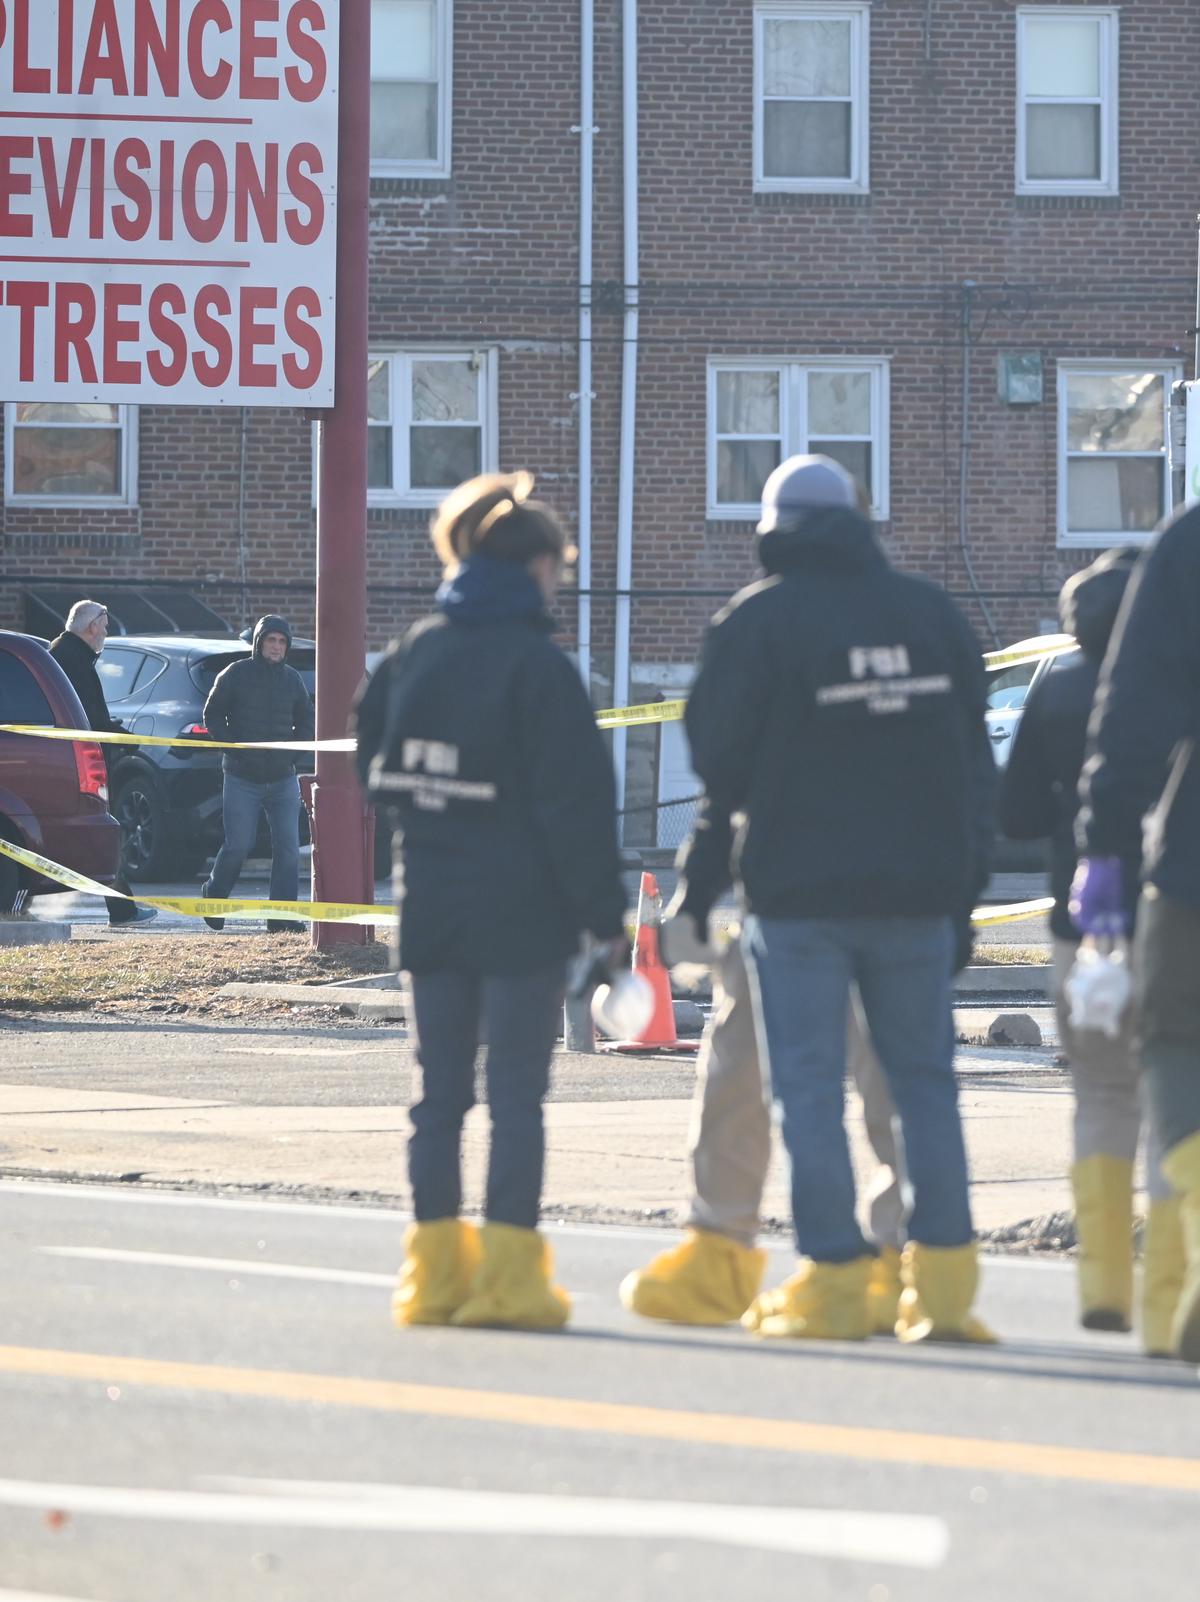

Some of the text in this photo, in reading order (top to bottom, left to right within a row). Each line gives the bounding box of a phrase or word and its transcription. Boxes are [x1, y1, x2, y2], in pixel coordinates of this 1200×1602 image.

[0, 0, 327, 103] LIANCES
[0, 136, 324, 245] EVISIONS
[0, 280, 323, 390] TRESSES
[849, 644, 911, 679] FBI
